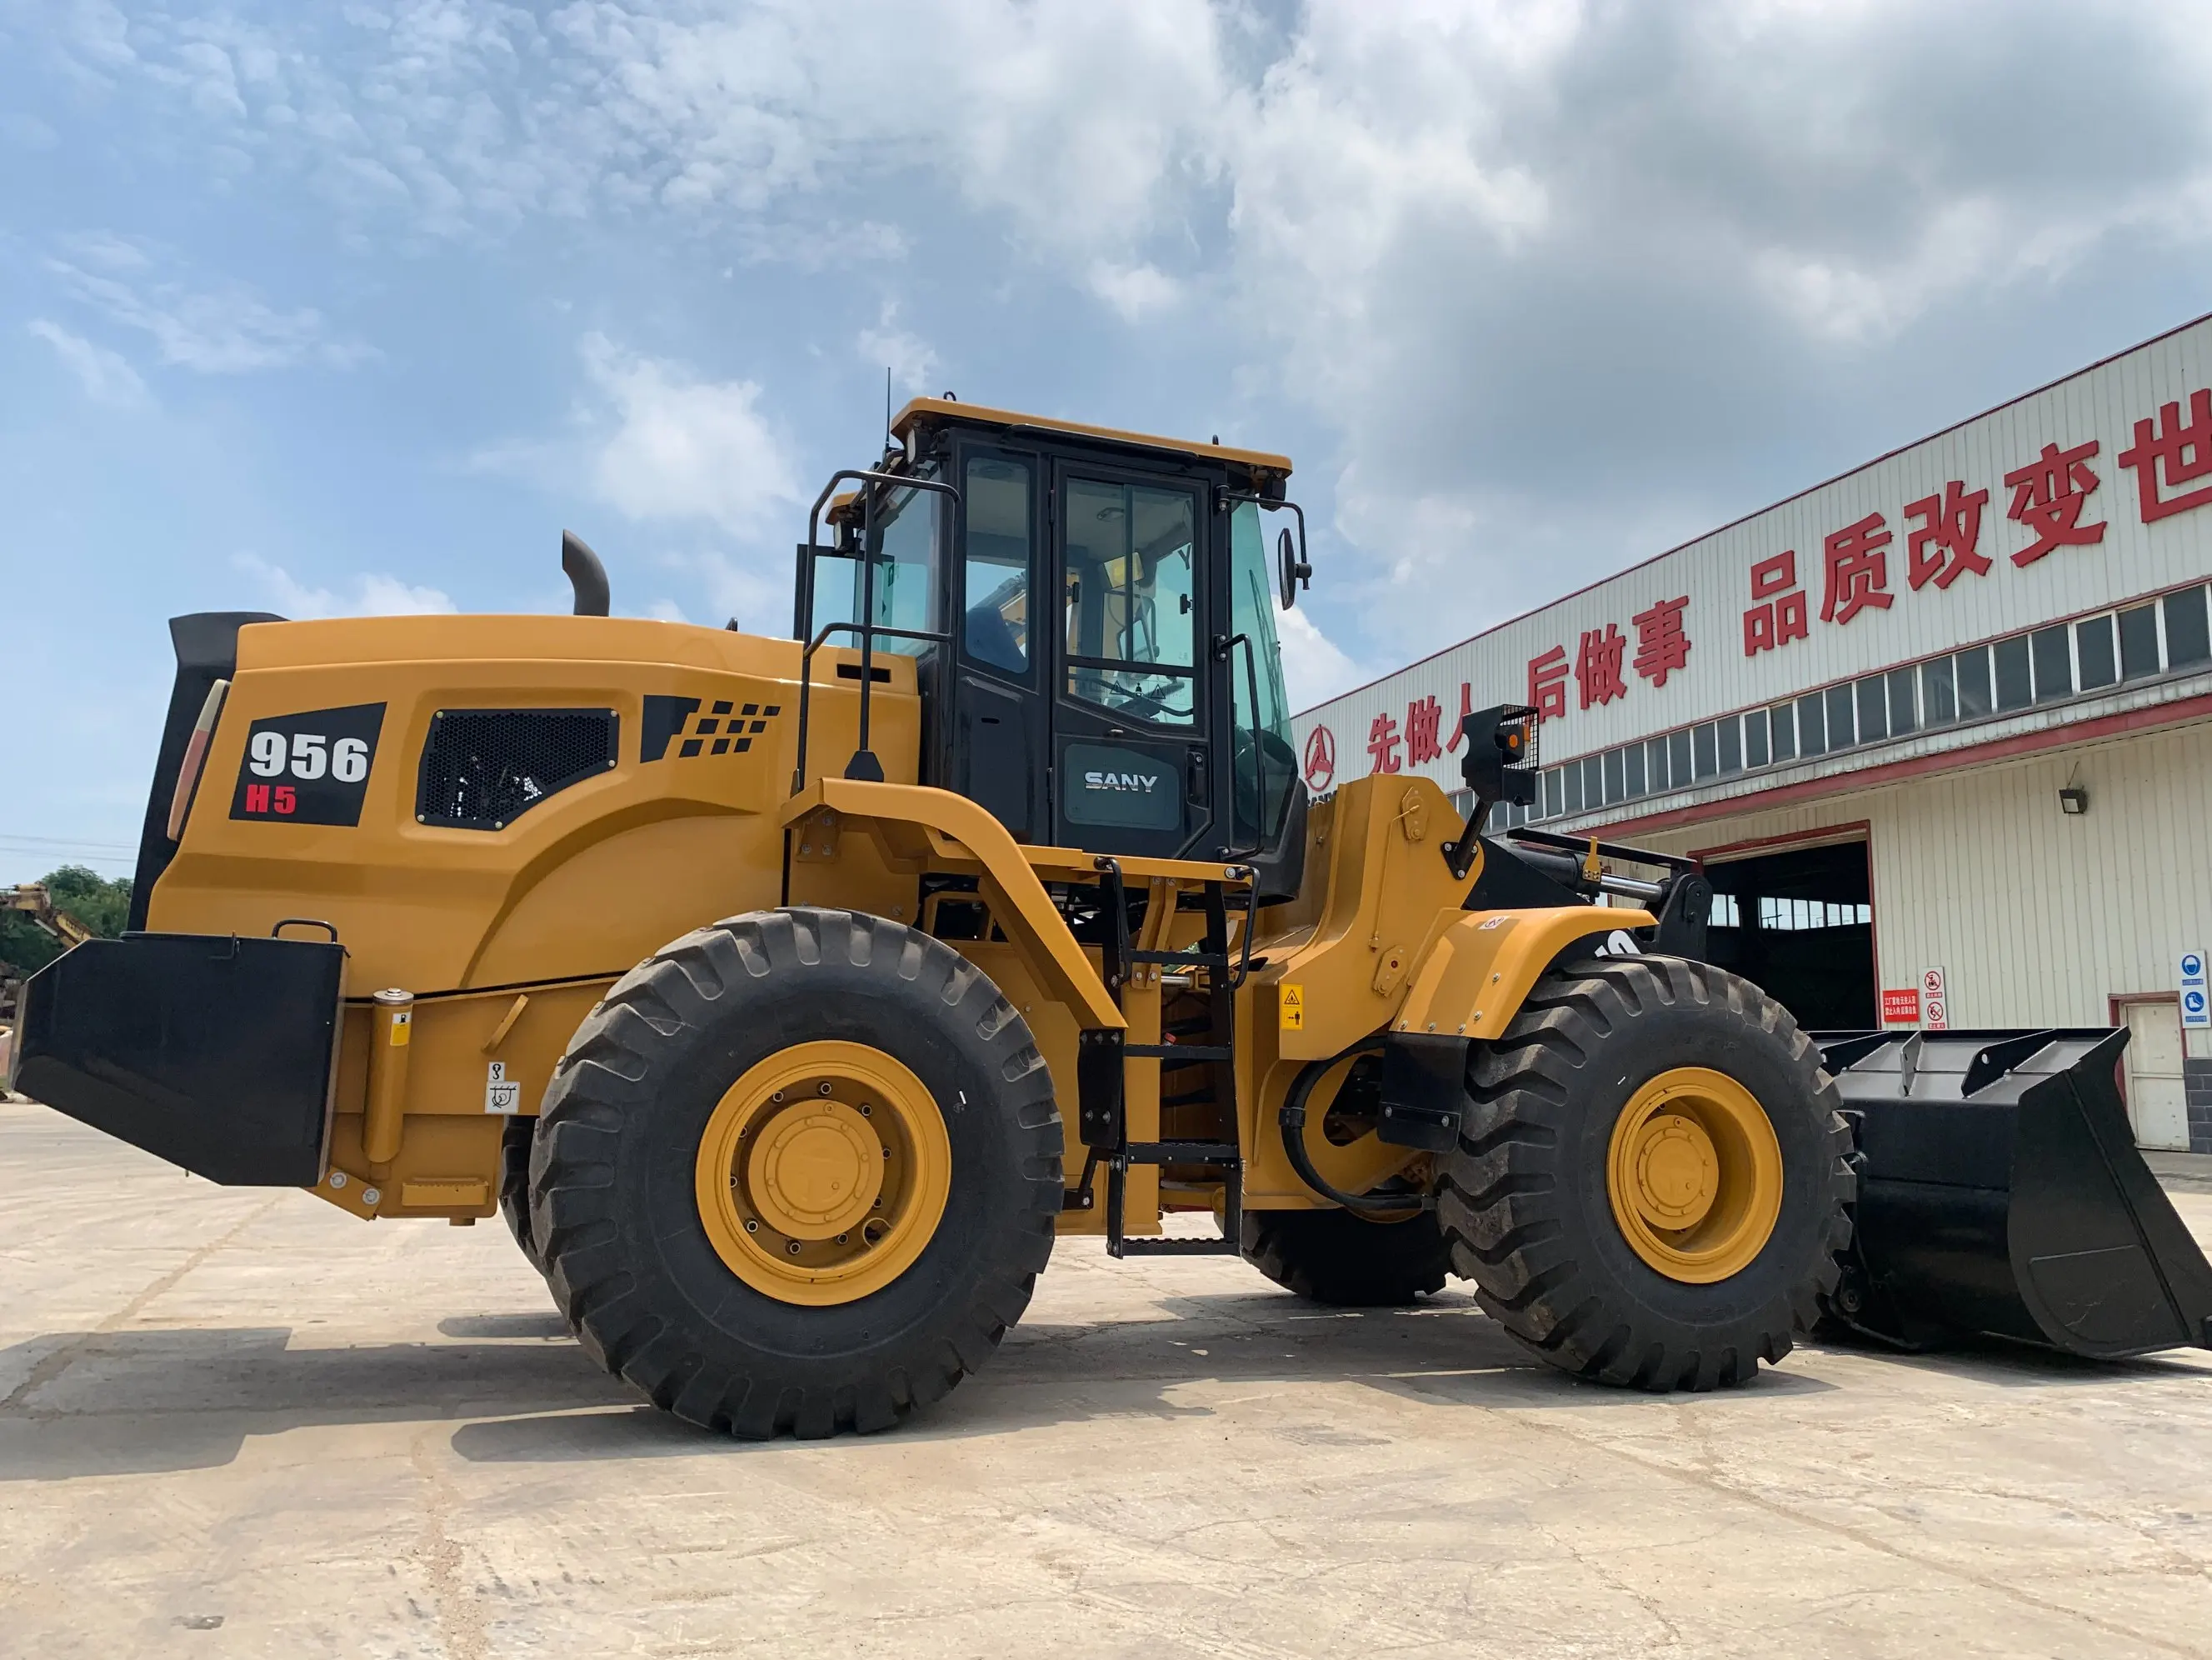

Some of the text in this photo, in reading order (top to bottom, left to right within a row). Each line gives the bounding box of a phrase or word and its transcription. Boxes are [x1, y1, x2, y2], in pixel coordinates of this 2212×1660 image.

[1525, 595, 1692, 725] 后做事
[1743, 388, 2212, 657] 品质改变世
[249, 731, 368, 782] 956
[246, 784, 297, 814] H5
[1085, 772, 1158, 792] SANY
